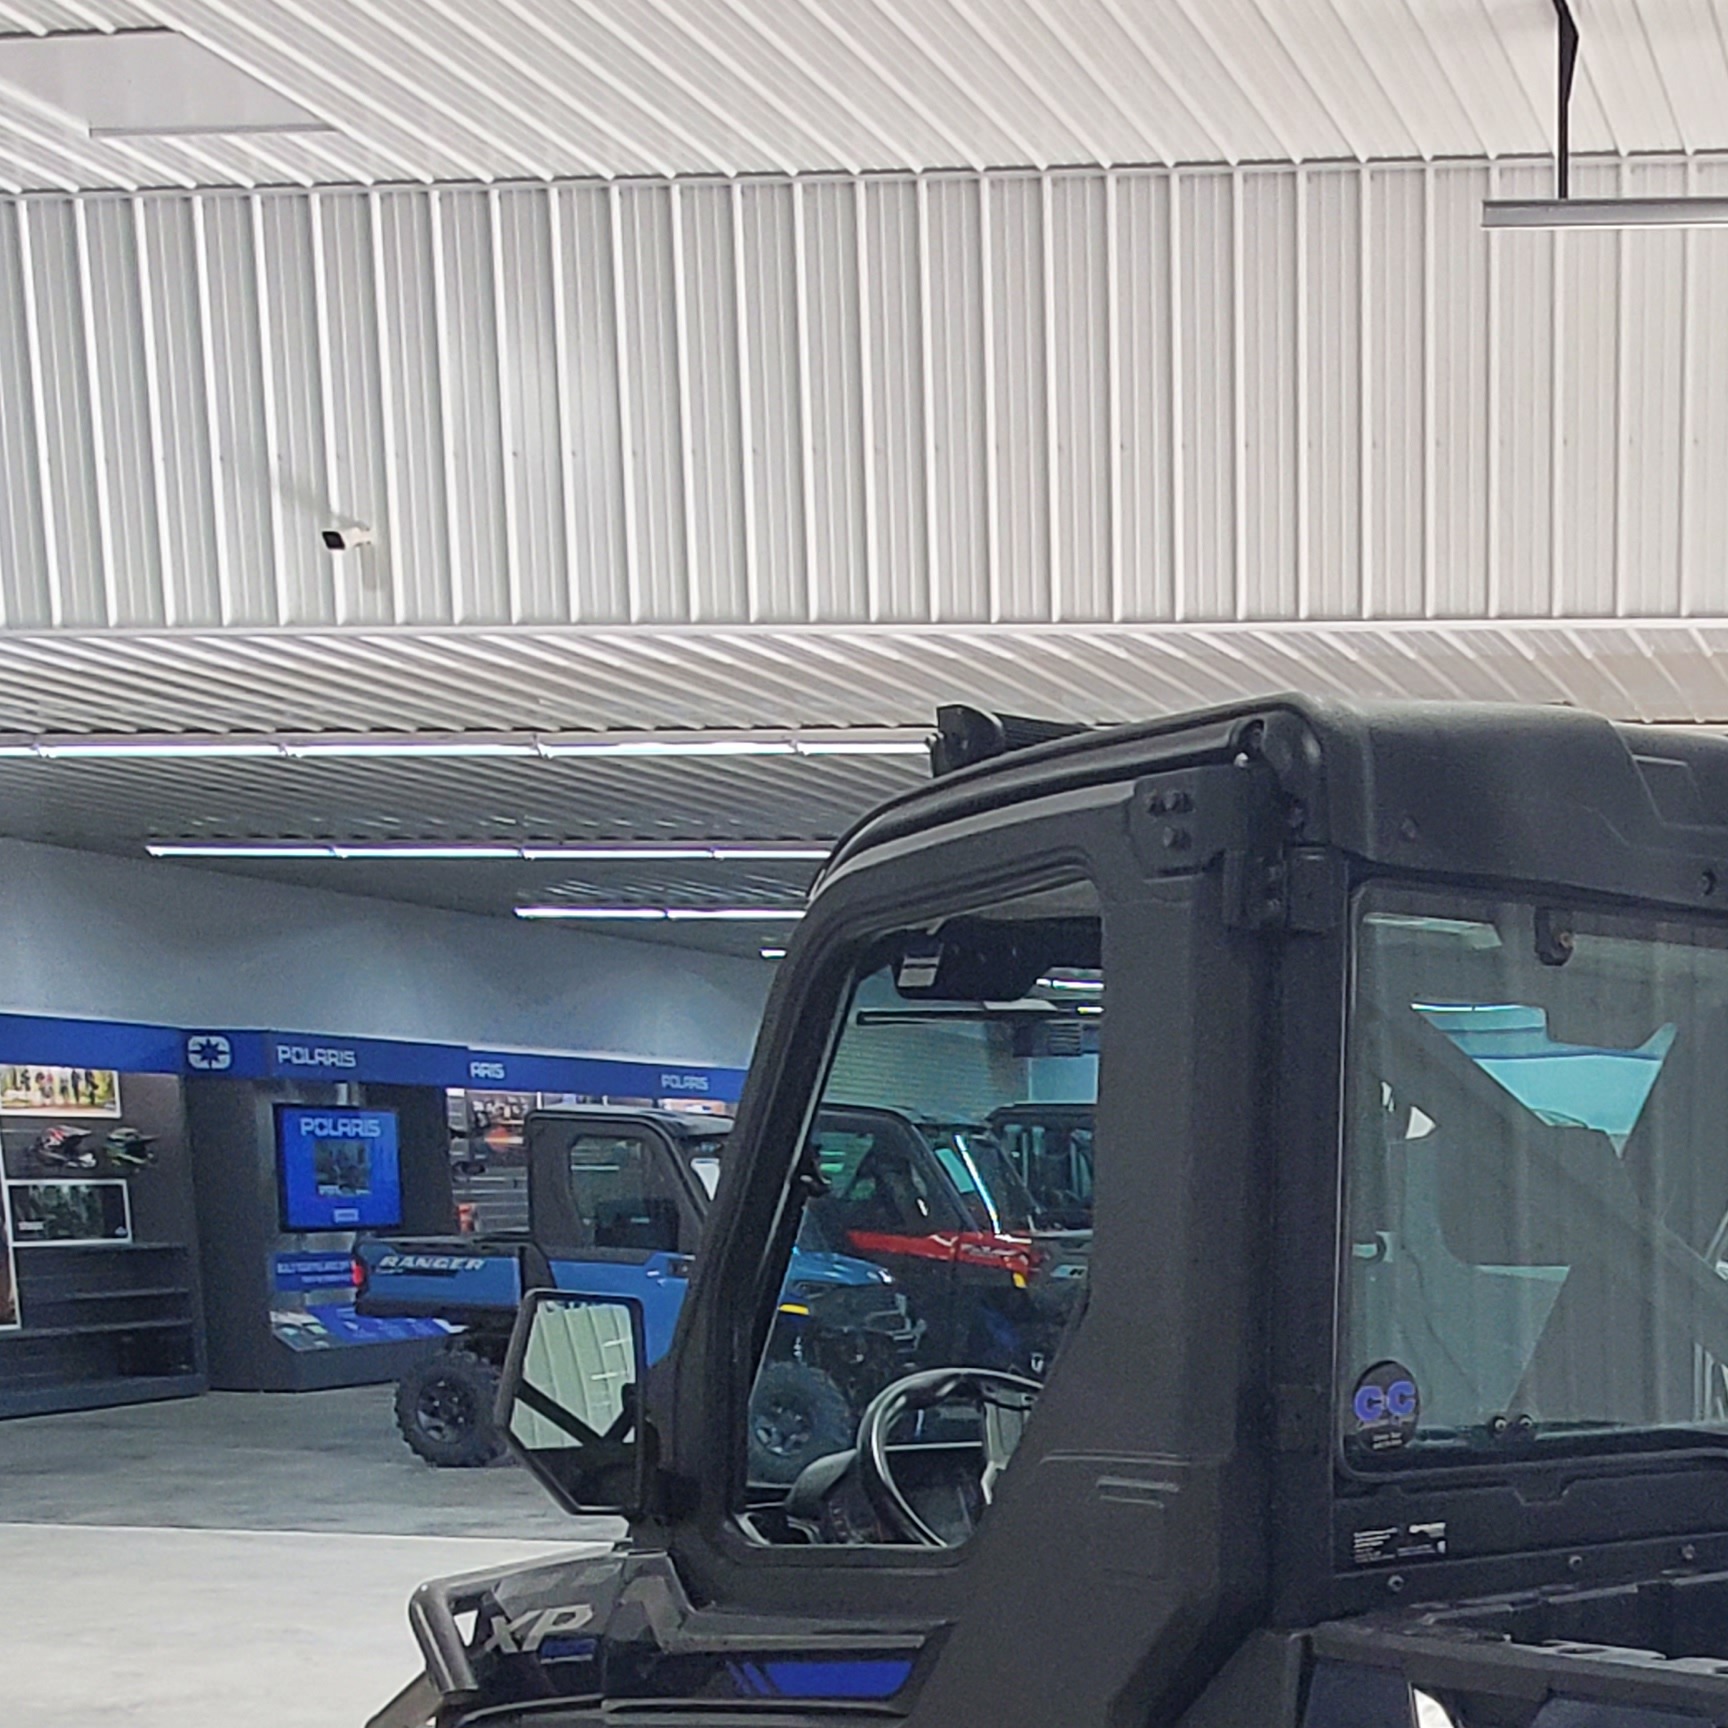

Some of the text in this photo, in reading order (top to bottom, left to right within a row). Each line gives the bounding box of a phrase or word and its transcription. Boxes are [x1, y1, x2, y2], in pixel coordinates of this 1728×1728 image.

[276, 1045, 357, 1068] POLARIS
[661, 1074, 709, 1091] POLARIS
[300, 1117, 381, 1137] POLARIS
[379, 1255, 486, 1270] RANGER
[484, 1603, 593, 1653] XP
